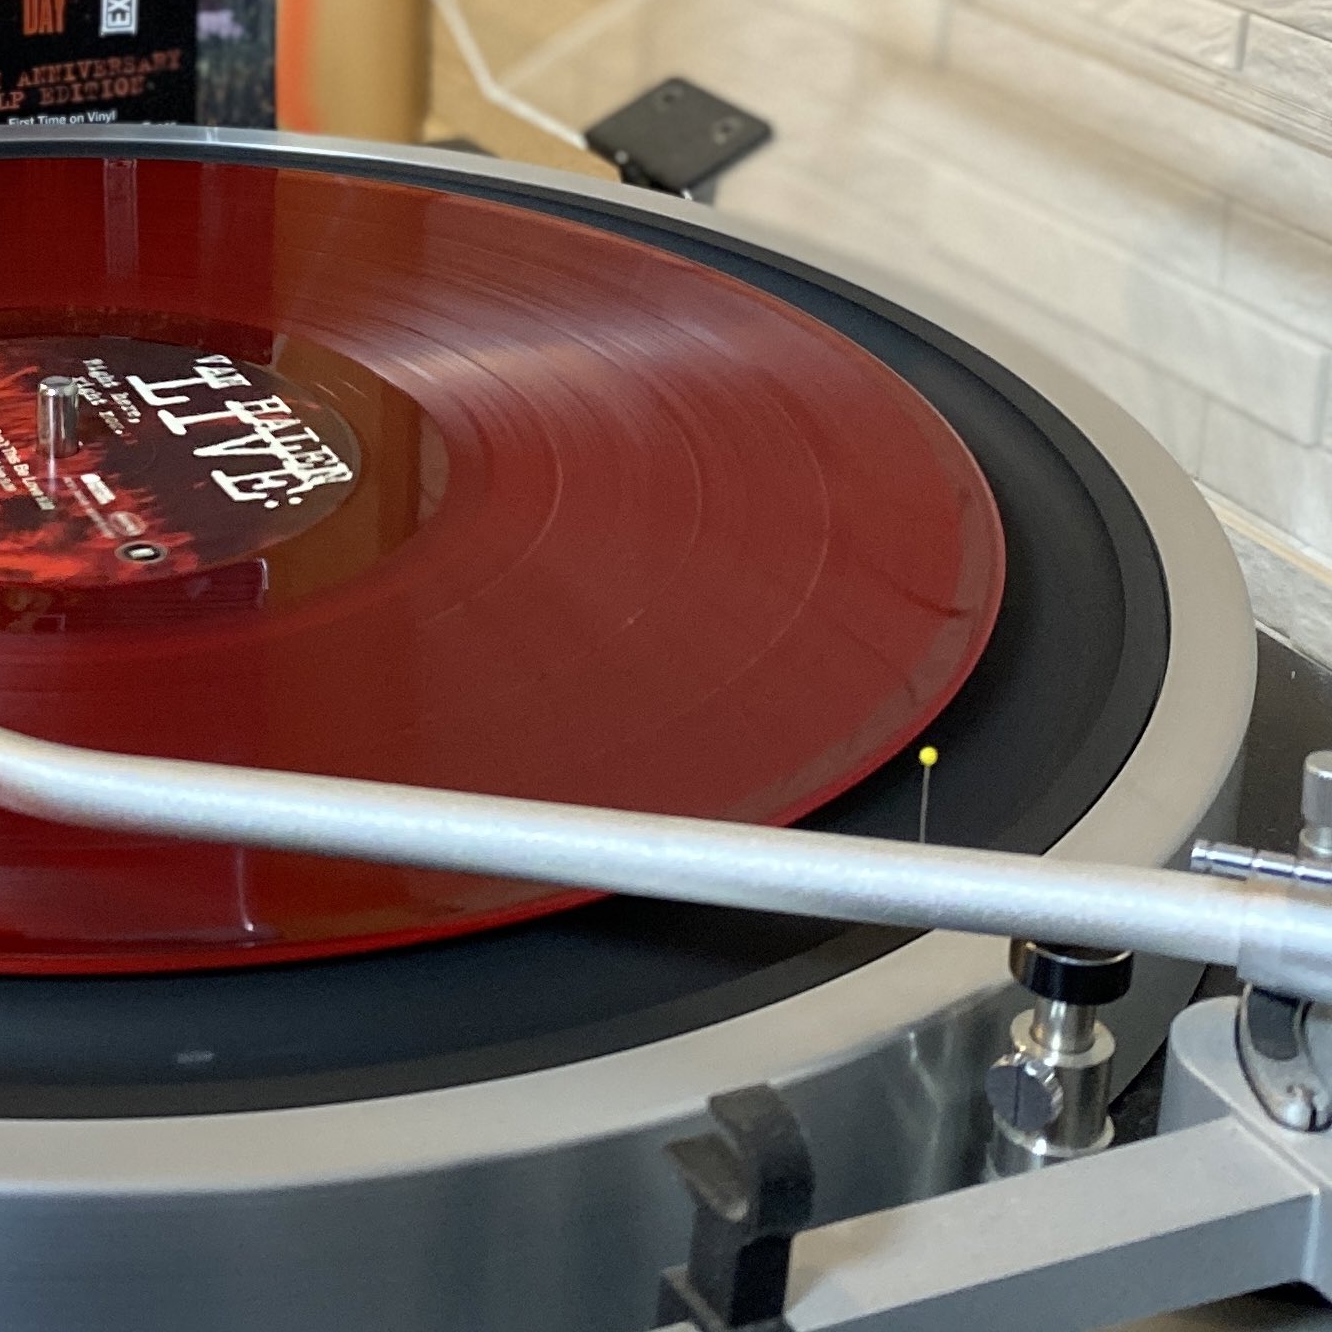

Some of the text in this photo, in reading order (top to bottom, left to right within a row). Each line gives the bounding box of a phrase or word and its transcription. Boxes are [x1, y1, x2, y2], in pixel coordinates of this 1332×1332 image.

[17, 49, 183, 87] ANNIVERSARY
[39, 76, 146, 106] EDITION
[37, 115, 67, 125] Time
[69, 114, 85, 124] on
[87, 109, 116, 124] Vinyl
